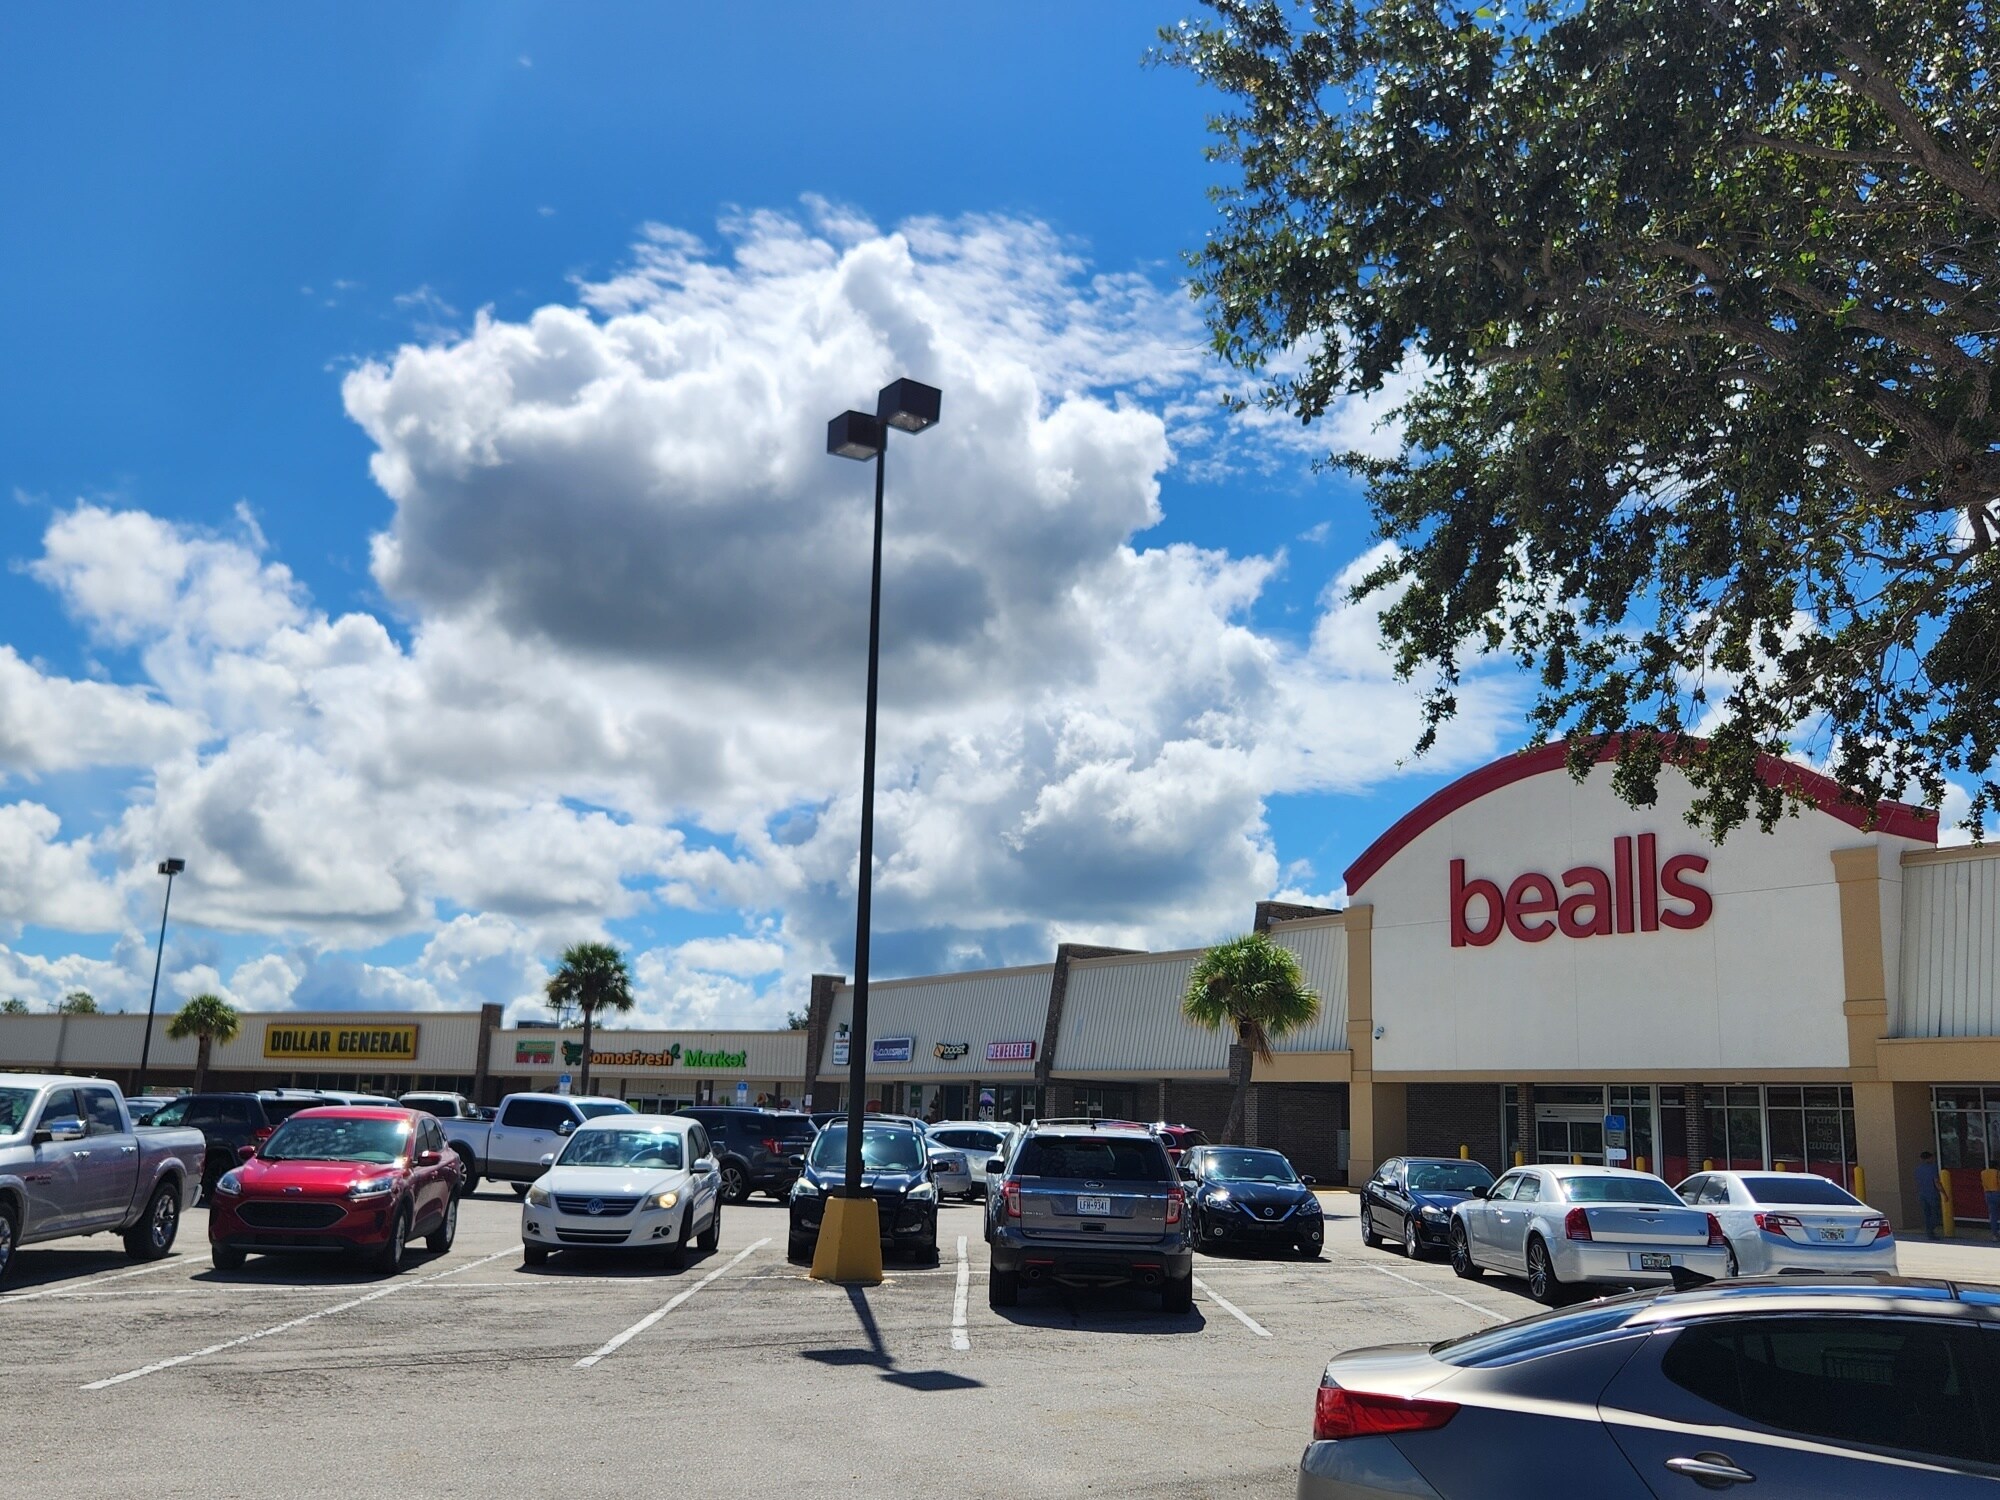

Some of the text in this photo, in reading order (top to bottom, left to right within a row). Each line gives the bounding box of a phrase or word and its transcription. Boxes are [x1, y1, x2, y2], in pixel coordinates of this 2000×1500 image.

[1450, 833, 1713, 947] bealls
[271, 1030, 411, 1052] DOLLAR GENERAL
[944, 1043, 965, 1054] boost
[589, 1049, 747, 1067] omosFresh Market
[991, 1044, 1025, 1057] JEWELERS
